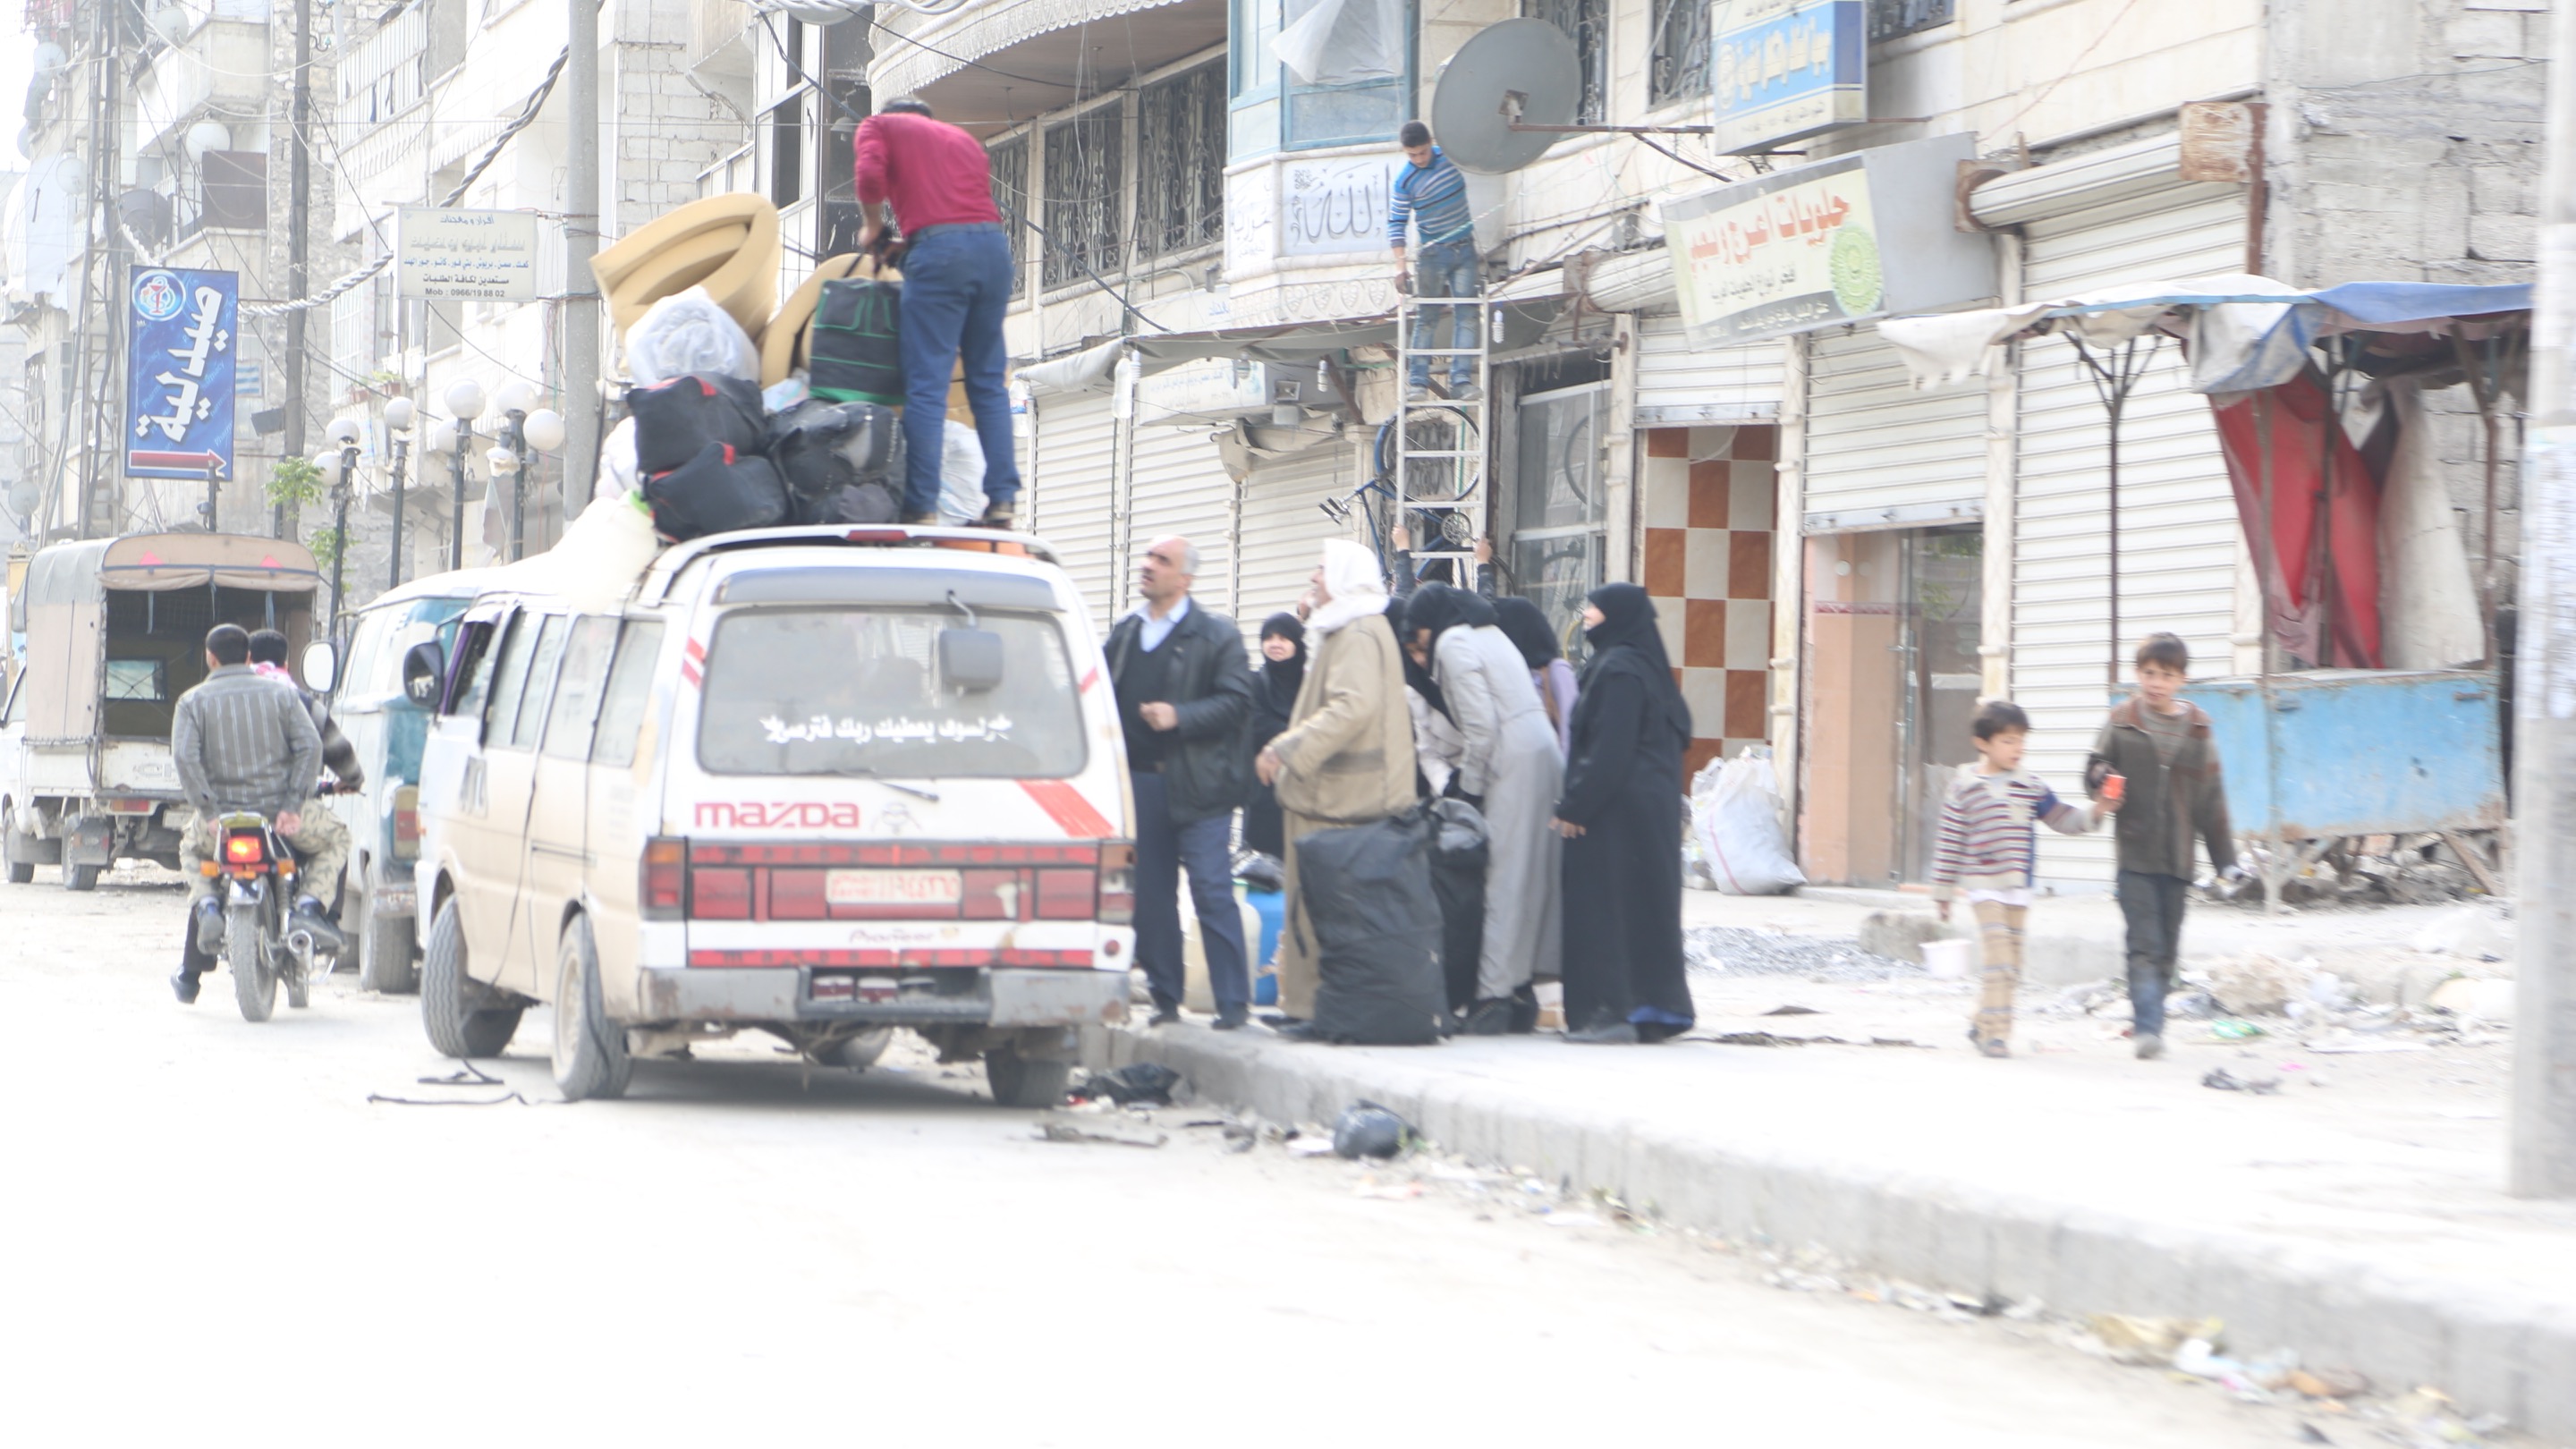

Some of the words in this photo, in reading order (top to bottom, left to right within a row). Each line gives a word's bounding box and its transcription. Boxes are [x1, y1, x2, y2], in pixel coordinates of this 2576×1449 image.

[1775, 185, 1852, 248] حلويات
[422, 274, 453, 284] الطلبات
[454, 274, 476, 284] لكافة
[478, 275, 510, 287] مستعدين
[425, 287, 444, 296] Mob
[495, 289, 505, 298] 02
[136, 286, 229, 443] صيدلية
[835, 716, 872, 745] ربك
